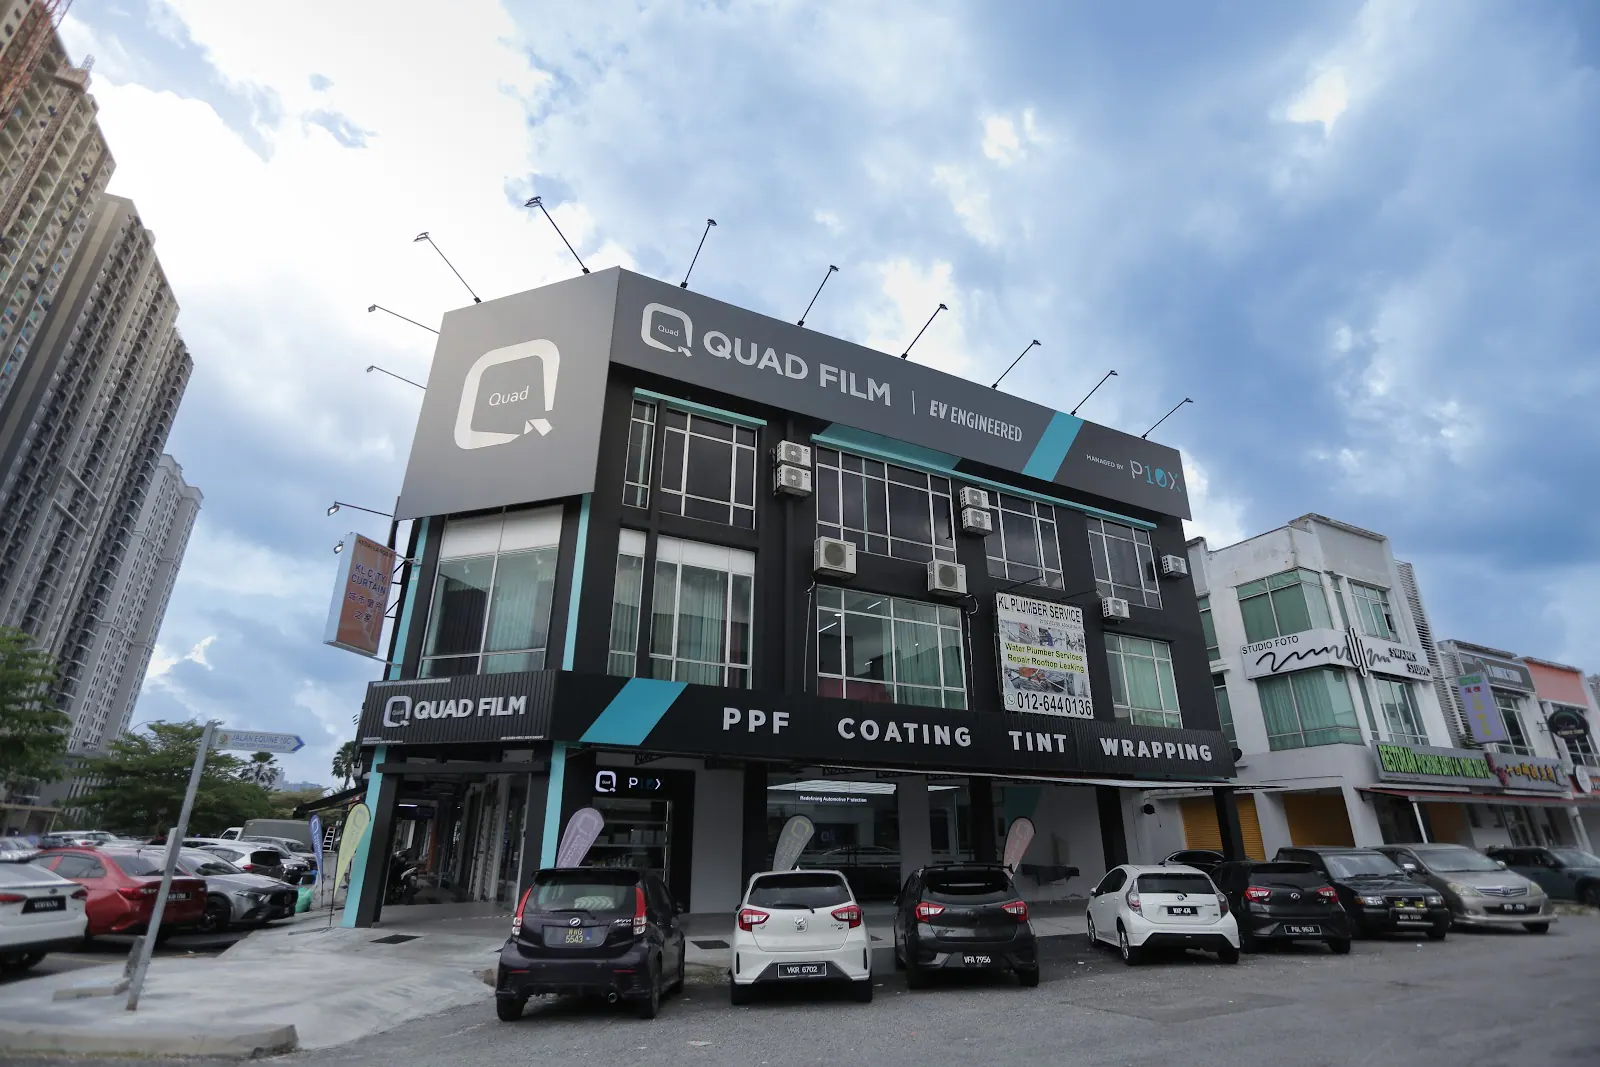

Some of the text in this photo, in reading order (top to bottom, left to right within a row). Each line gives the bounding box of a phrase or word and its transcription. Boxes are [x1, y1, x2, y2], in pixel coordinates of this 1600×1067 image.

[658, 324, 679, 337] Quad
[703, 330, 892, 407] QUAD FILM
[488, 384, 530, 407] Quad
[929, 400, 1022, 442] EV ENGINEERED
[1086, 454, 1115, 468] MANAGED
[355, 563, 366, 575] KL
[351, 573, 387, 595] CURTAIN
[998, 596, 1081, 623] KL PLUMBER SERVICE
[1004, 642, 1083, 662] Water Plumber Services
[1242, 635, 1299, 655] STUDIO FOTO
[1007, 654, 1085, 674] Repair Rooftop Leaking
[414, 695, 528, 720] QUAD FILM
[1017, 691, 1092, 716] 012-6440136
[231, 733, 253, 742] JALAN
[255, 735, 278, 744] EQUINE
[722, 707, 1213, 762] PPF COATING TINT WRAPPING
[786, 966, 818, 974] VKR 6702
[976, 956, 991, 964] 7956
